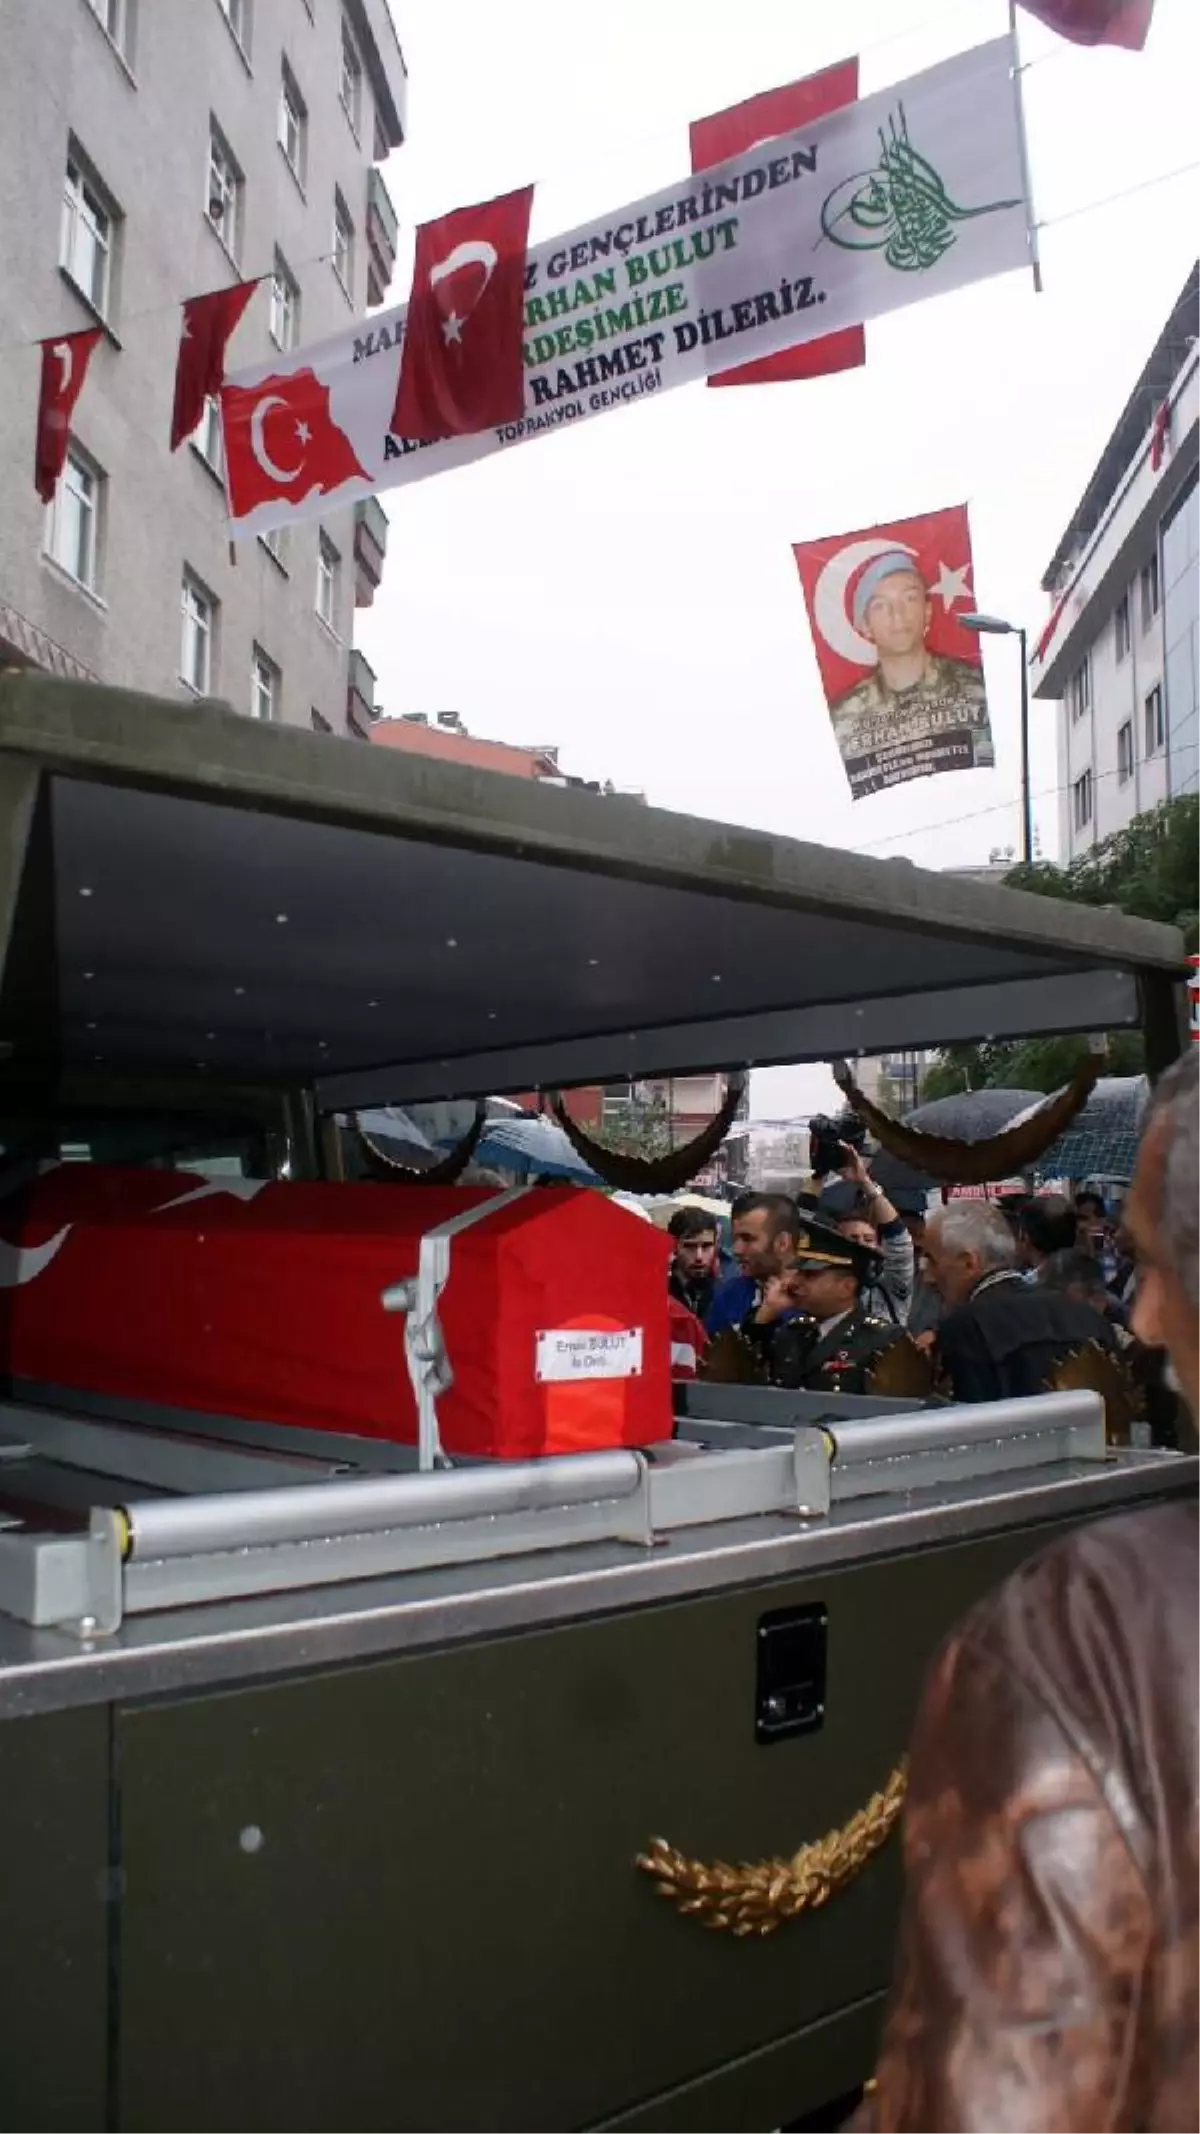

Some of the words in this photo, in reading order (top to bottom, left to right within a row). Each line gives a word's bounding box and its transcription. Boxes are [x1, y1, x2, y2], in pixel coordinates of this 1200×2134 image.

[546, 144, 818, 279] GENÇLERİNDEN
[523, 267, 617, 327] RHAN
[625, 217, 739, 287] BULUT
[529, 332, 665, 405] RAHMET
[673, 276, 827, 354] DİLERİZ.
[495, 401, 586, 444] TOPRAKYOL
[589, 367, 662, 409] GENÇLİĞİ
